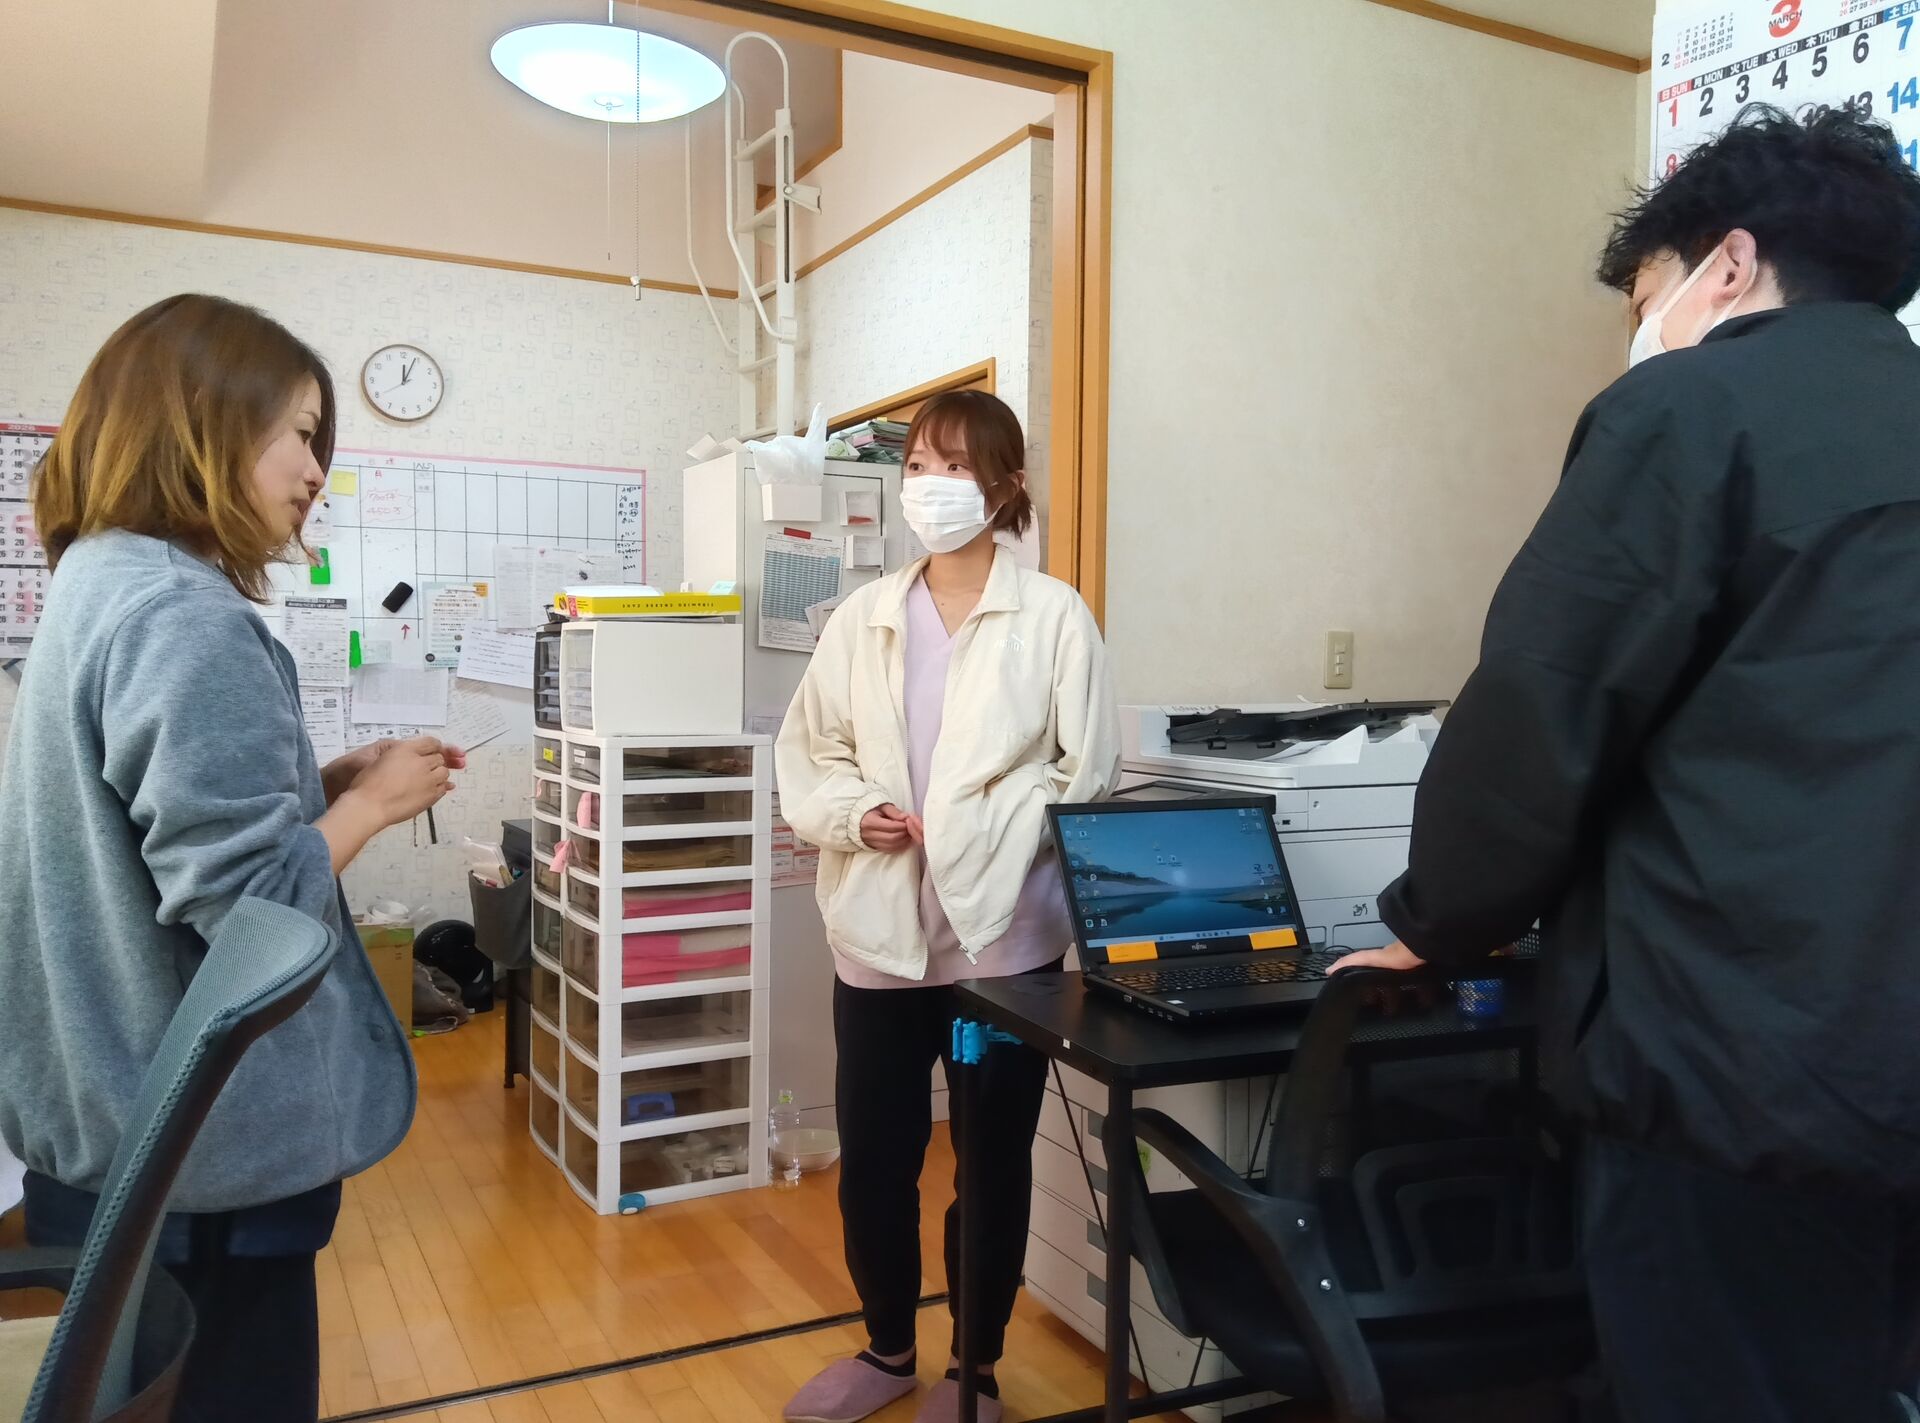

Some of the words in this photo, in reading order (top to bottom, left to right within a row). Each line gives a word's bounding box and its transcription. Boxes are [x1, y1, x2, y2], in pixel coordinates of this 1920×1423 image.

[1768, 0, 1803, 38] 3
[1768, 11, 1803, 29] MARCH
[1661, 91, 1671, 100] 日
[1670, 83, 1688, 97] SUN
[1693, 76, 1703, 88] 月
[1704, 70, 1724, 86] MON
[1730, 63, 1741, 75] 火
[1742, 57, 1760, 71] TUE
[1766, 52, 1777, 62] 水
[1778, 43, 1799, 58] WED
[1806, 37, 1817, 48] 木
[1819, 29, 1839, 44] THU
[1862, 14, 1878, 29] FRI
[1888, 7, 1900, 19] 土
[1661, 53, 1670, 67] 2
[1669, 99, 1678, 127] 1
[1699, 87, 1714, 117] 2
[1735, 74, 1750, 103] 3
[1772, 60, 1788, 90] 4
[1811, 46, 1828, 77] 5
[1853, 32, 1870, 63] 6
[1896, 16, 1914, 51] 7
[1843, 91, 1873, 122] 13
[1886, 76, 1920, 114] 14
[369, 376, 375, 384] 9
[375, 391, 380, 399] 8
[33, 438, 39, 446] 5
[14, 472, 24, 480] 25
[14, 538, 24, 546] 20
[15, 550, 24, 558] 27
[36, 569, 41, 577] 2
[34, 592, 43, 600] 16
[15, 603, 25, 612] 22
